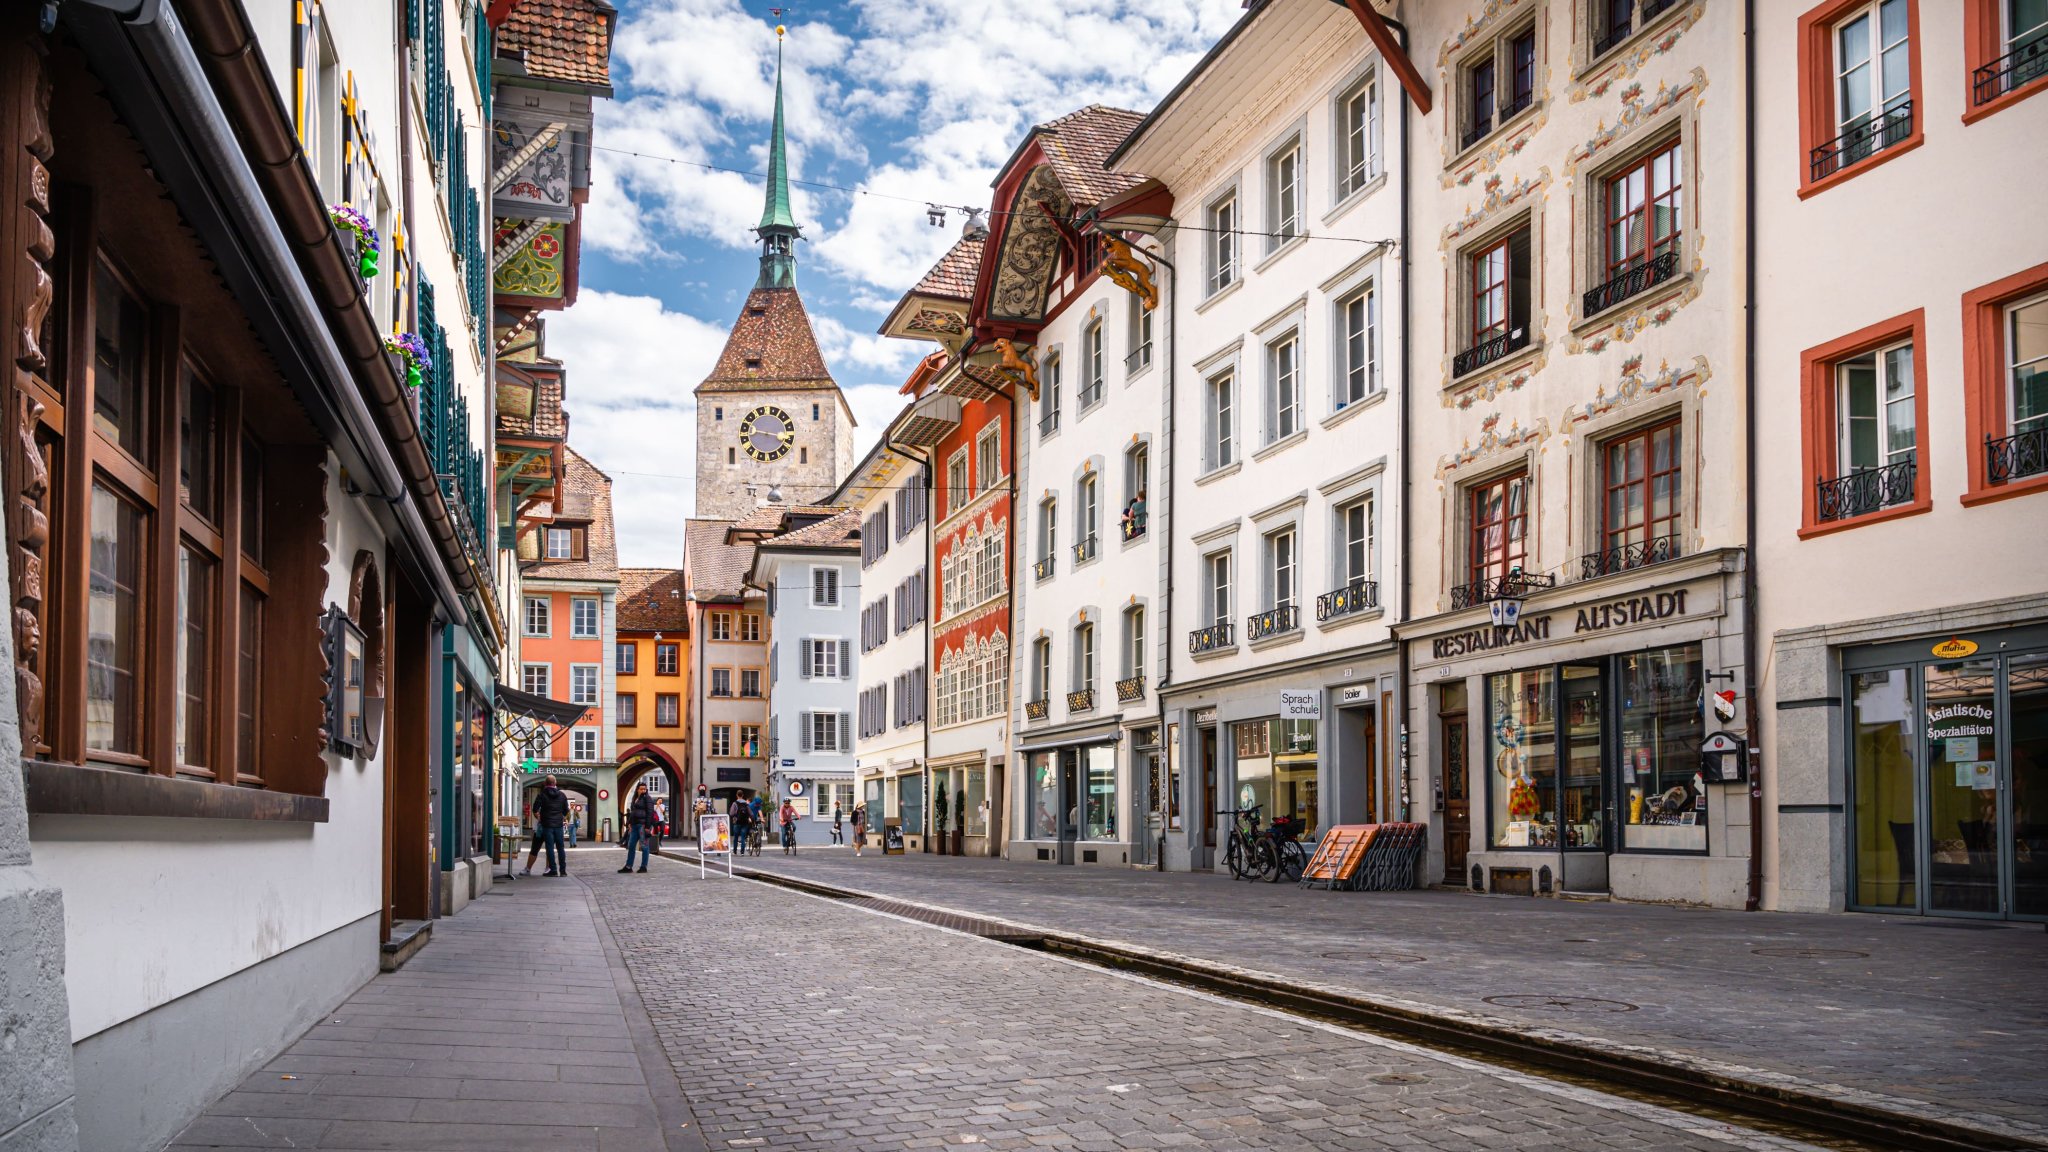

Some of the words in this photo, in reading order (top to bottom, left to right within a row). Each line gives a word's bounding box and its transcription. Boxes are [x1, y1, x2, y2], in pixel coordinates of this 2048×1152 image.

[1433, 616, 1551, 659] RESTAURANT
[1574, 588, 1688, 634] ALTSTADT
[1281, 693, 1313, 706] Sprach
[1290, 704, 1319, 714] schule
[1927, 703, 1993, 724] Asiatische
[1927, 724, 1993, 740] Spezialitäten
[546, 767, 569, 775] BODY
[570, 767, 593, 775] SHOP
